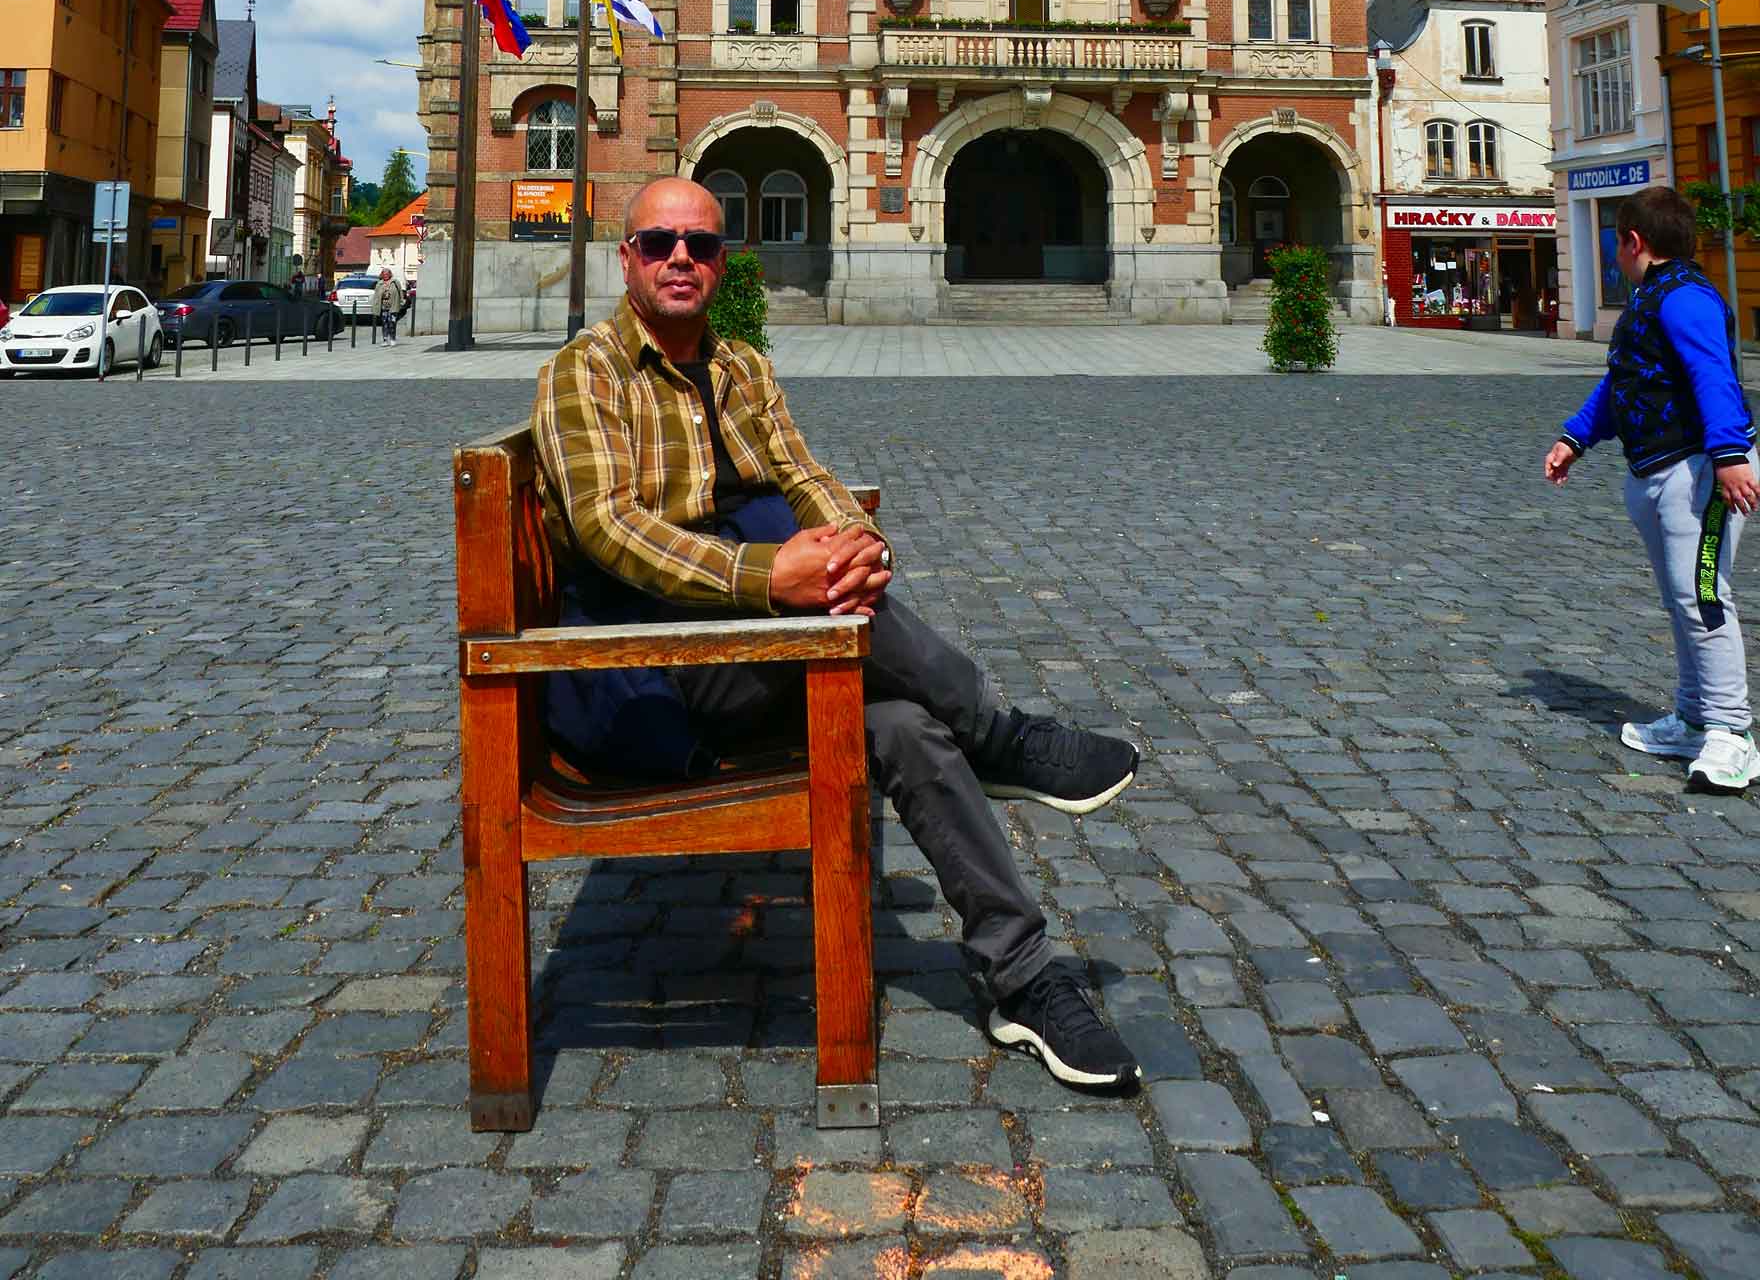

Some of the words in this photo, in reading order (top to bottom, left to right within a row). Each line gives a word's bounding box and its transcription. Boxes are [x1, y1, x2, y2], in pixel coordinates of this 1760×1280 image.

[1573, 168, 1621, 188] AUTODÍLY
[1628, 165, 1644, 183] DE
[1394, 209, 1476, 226] HRAČKY
[1481, 217, 1490, 226] &
[1496, 210, 1557, 227] DÁRKY
[1701, 535, 1719, 568] SURF
[1700, 568, 1717, 602] ZONE
